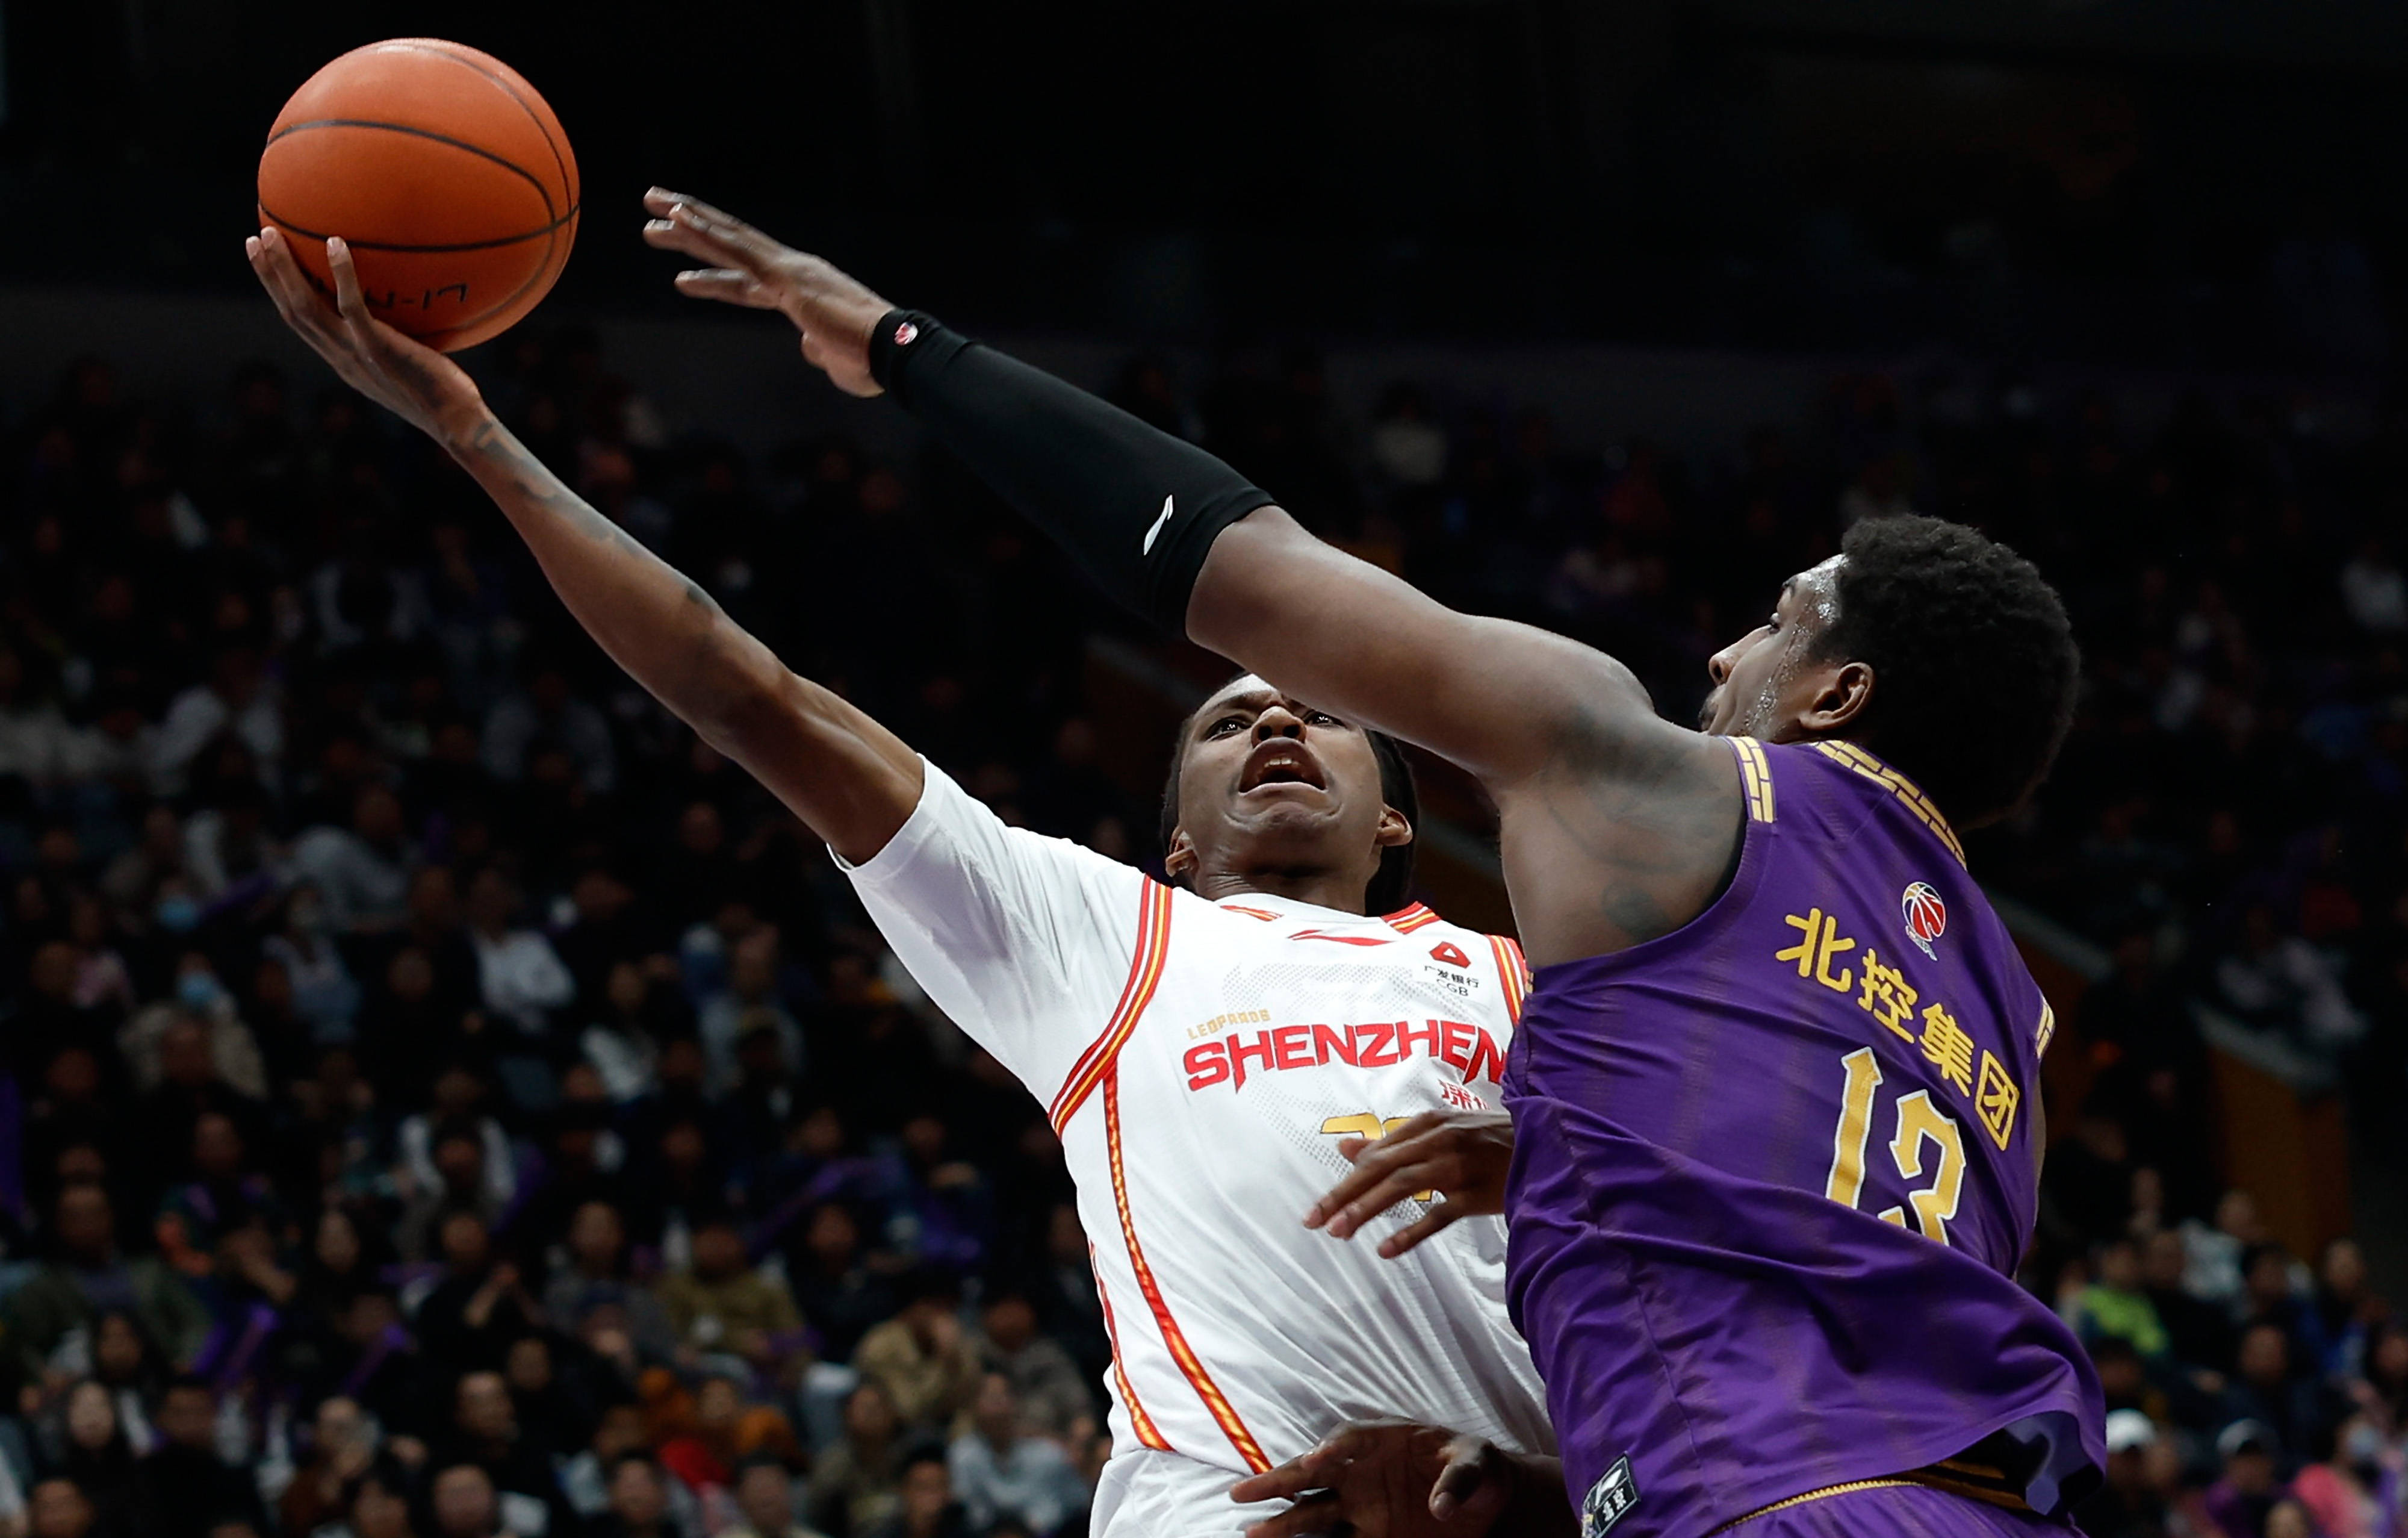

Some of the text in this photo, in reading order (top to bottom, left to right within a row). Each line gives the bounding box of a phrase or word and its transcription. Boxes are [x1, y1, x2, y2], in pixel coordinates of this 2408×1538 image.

[1424, 965, 1479, 988] 广发银行
[1436, 979, 1469, 997] CGB
[1187, 1008, 1271, 1040] LEOPARDS
[1775, 908, 2020, 1151] 北控集团
[1183, 1020, 1508, 1094] SHENZHEN
